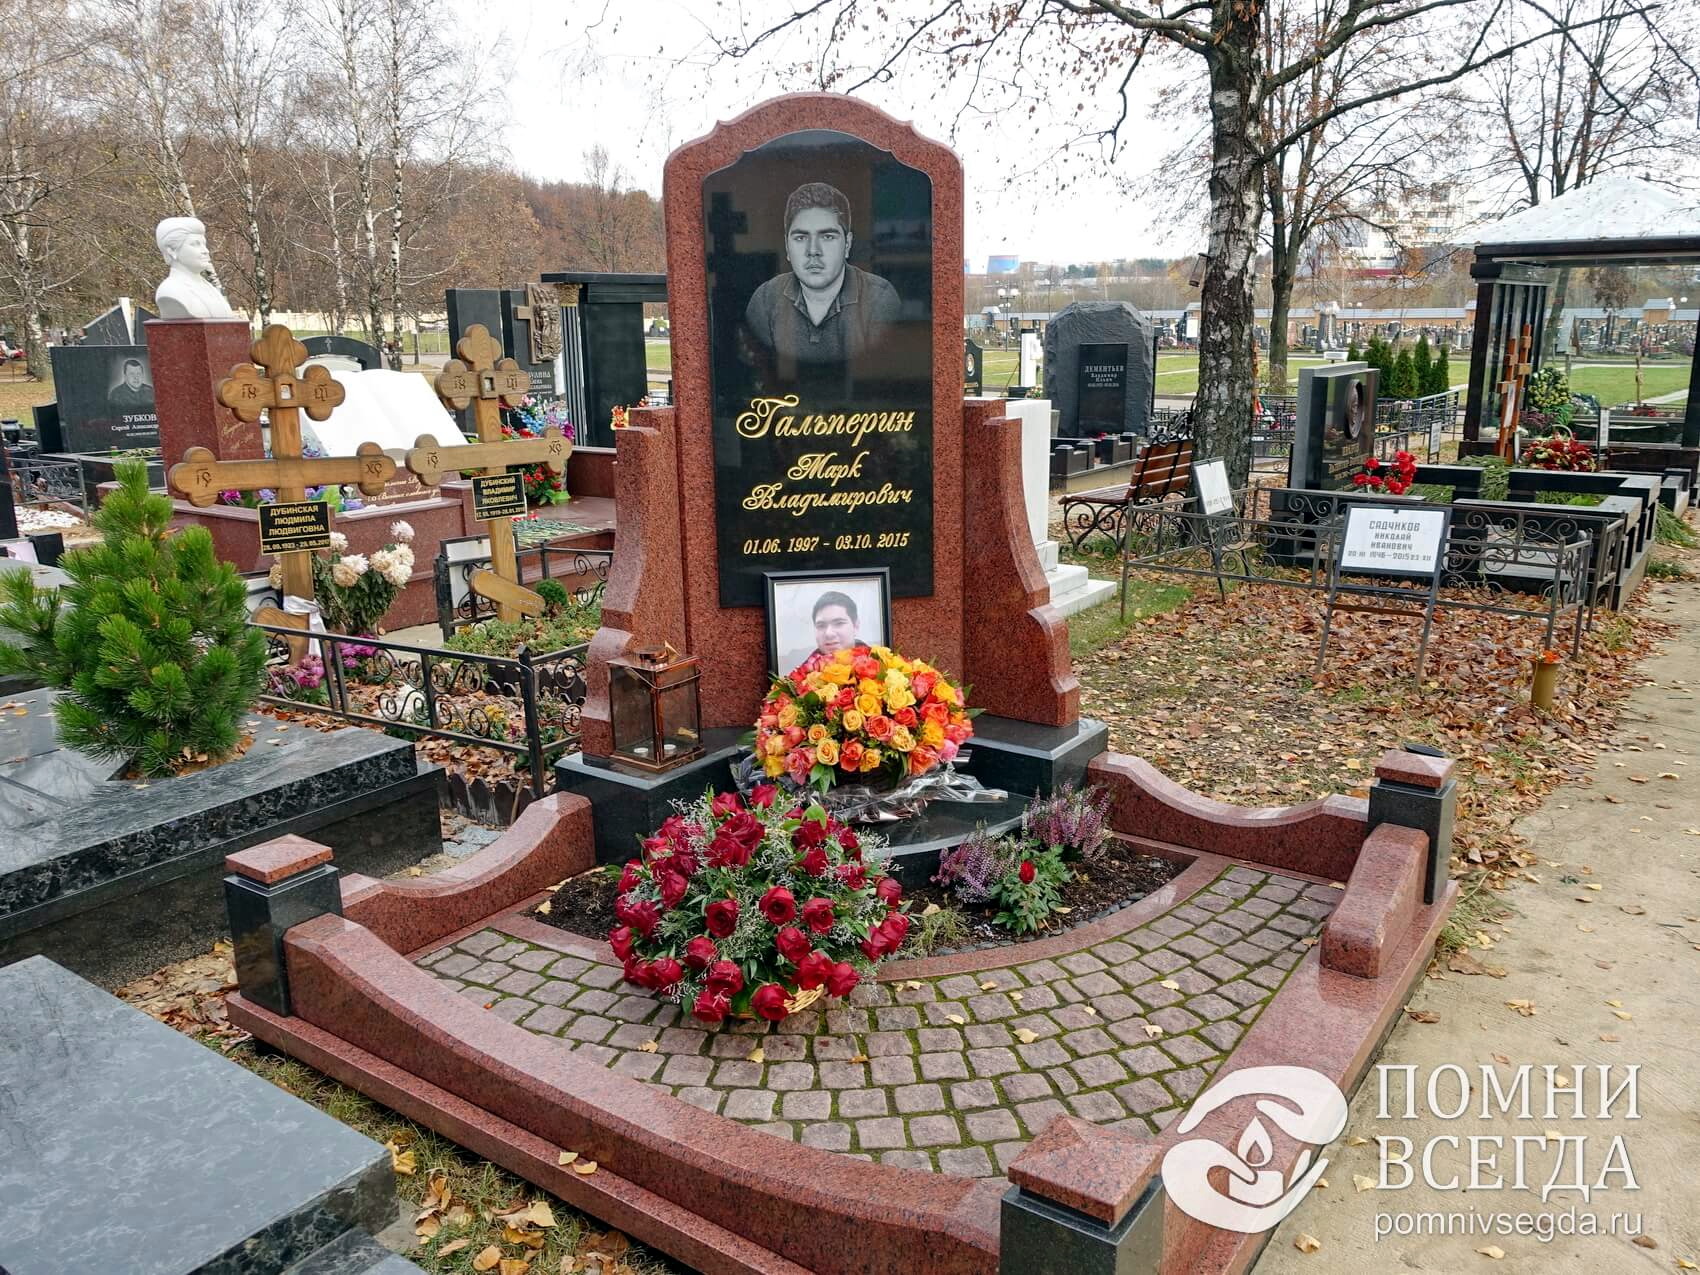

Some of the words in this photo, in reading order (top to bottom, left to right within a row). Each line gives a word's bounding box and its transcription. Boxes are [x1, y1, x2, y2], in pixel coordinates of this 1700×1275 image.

[736, 395, 915, 447] Гальперин
[787, 451, 869, 487] Марк
[742, 483, 913, 517] Владимирович
[270, 505, 319, 517] ДУБИНСКАЯ
[274, 515, 316, 525] ЛЮДМИЛА
[1369, 520, 1421, 532] САДЧИКОВ
[269, 524, 325, 536] ЛЮДВИГОВНА
[1374, 532, 1412, 541] НИКОЛАЙ
[743, 538, 782, 555] 01.06.
[787, 536, 820, 553] 1997
[835, 534, 873, 551] 03.10.
[877, 532, 910, 549] 2015
[1370, 541, 1414, 551] ИВАНОВИЧ
